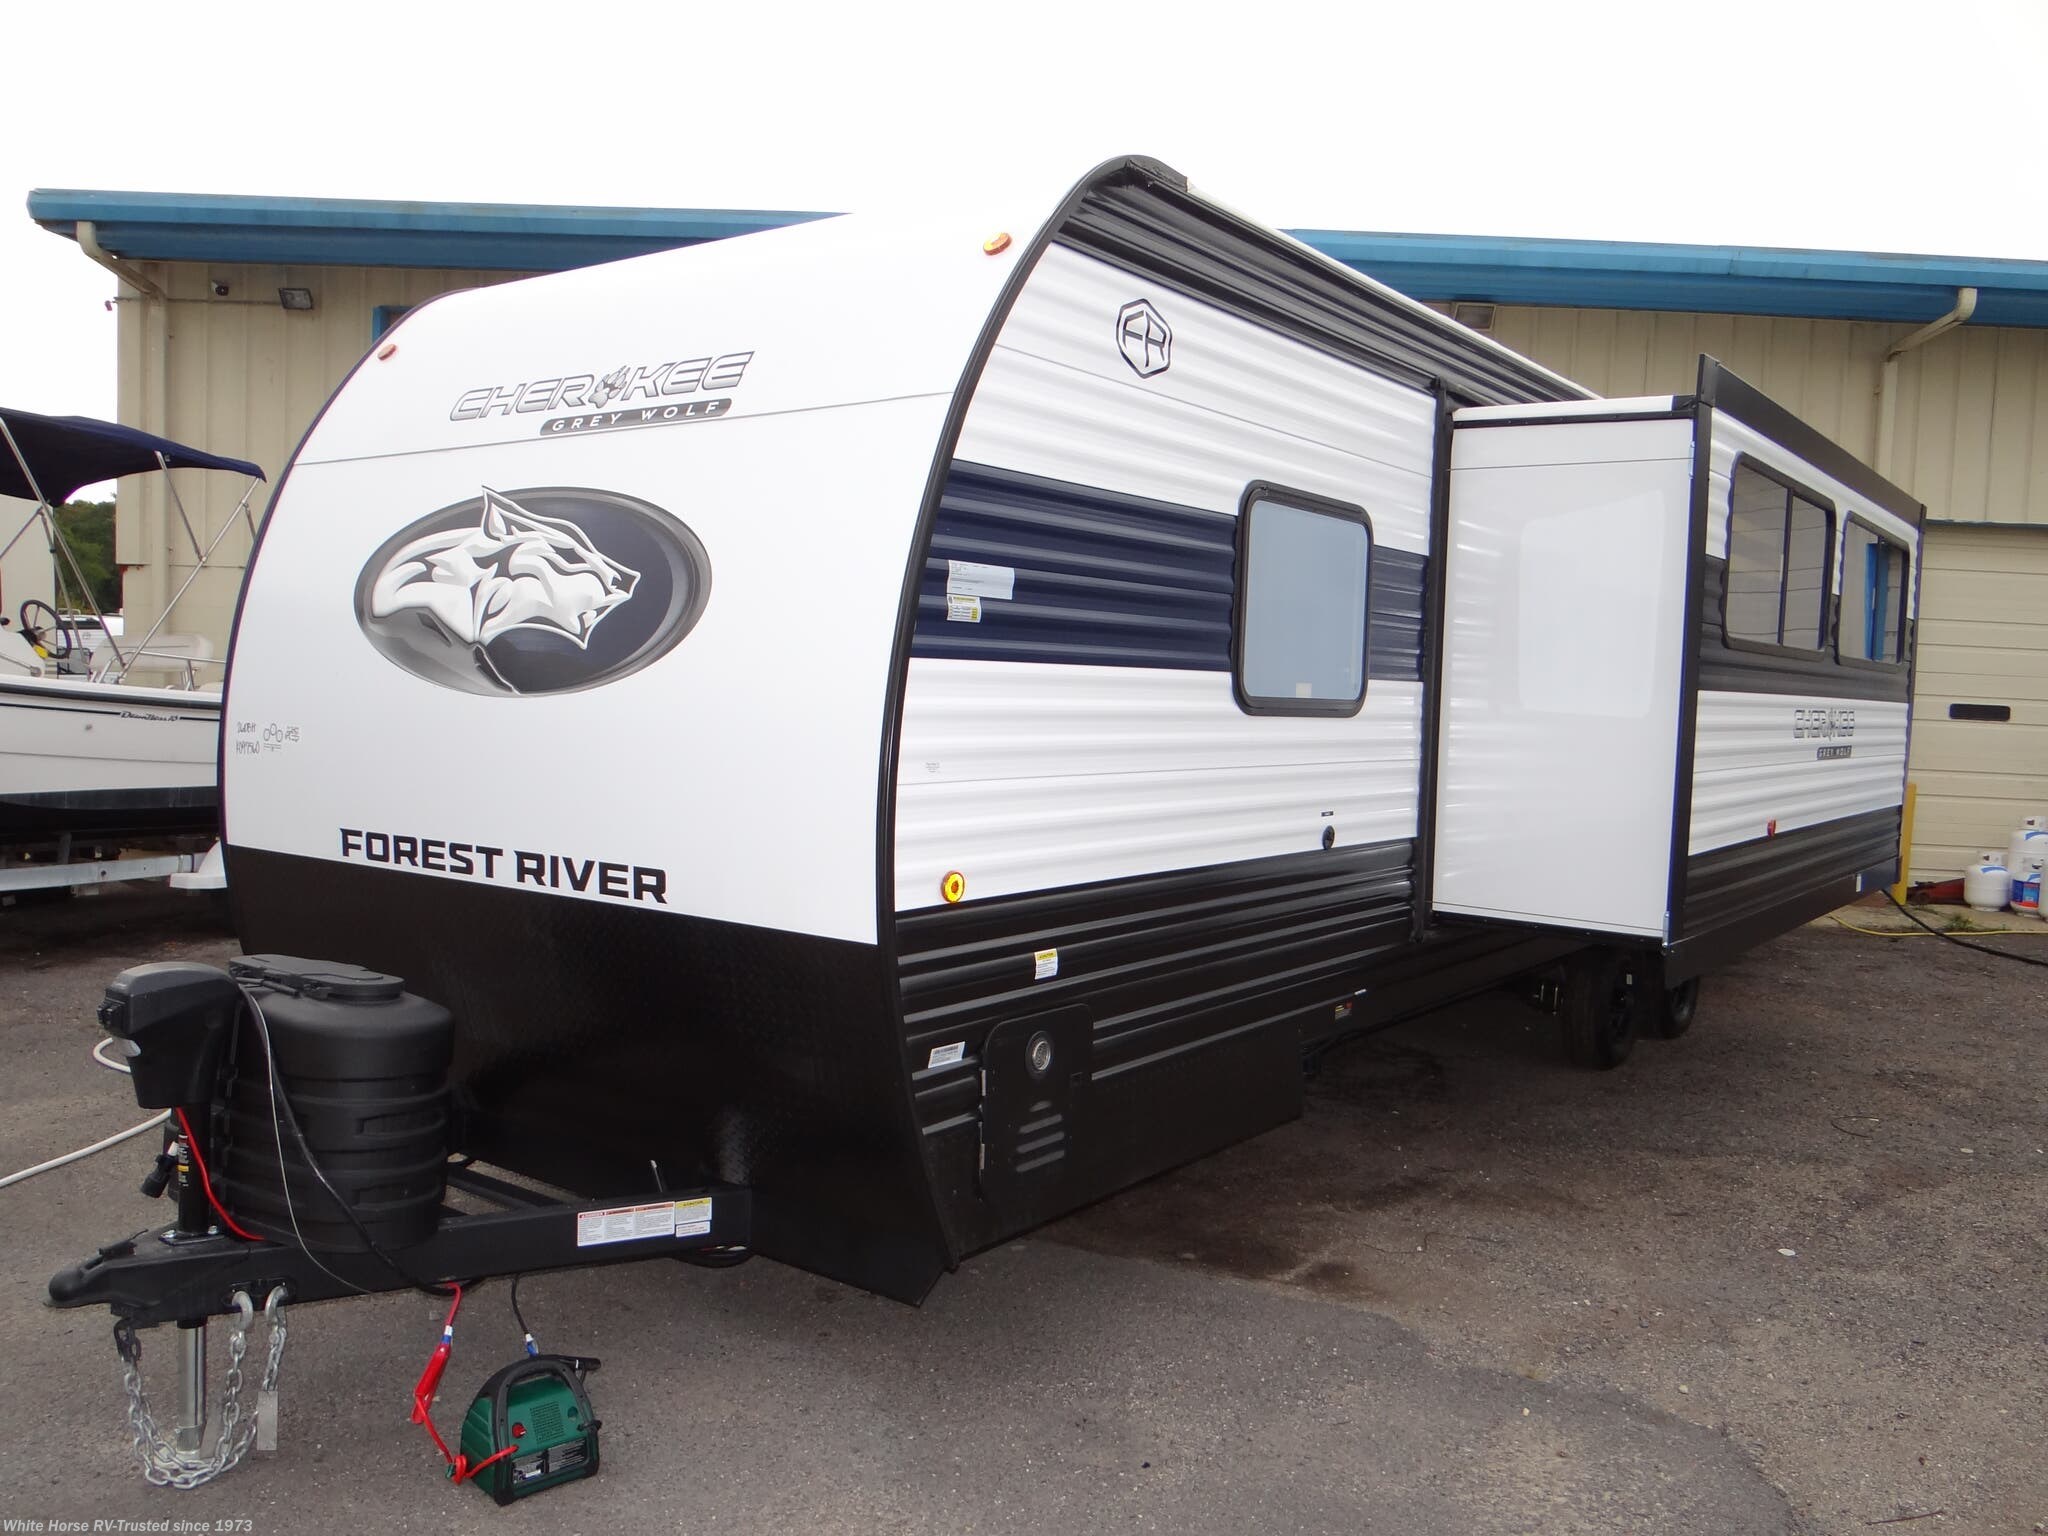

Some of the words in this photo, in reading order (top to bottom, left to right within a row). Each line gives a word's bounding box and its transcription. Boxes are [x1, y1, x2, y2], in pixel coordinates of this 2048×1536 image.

[552, 413, 622, 432] GREY
[641, 401, 720, 421] WOLF
[339, 828, 504, 879] FOREST
[513, 850, 668, 904] RIVER
